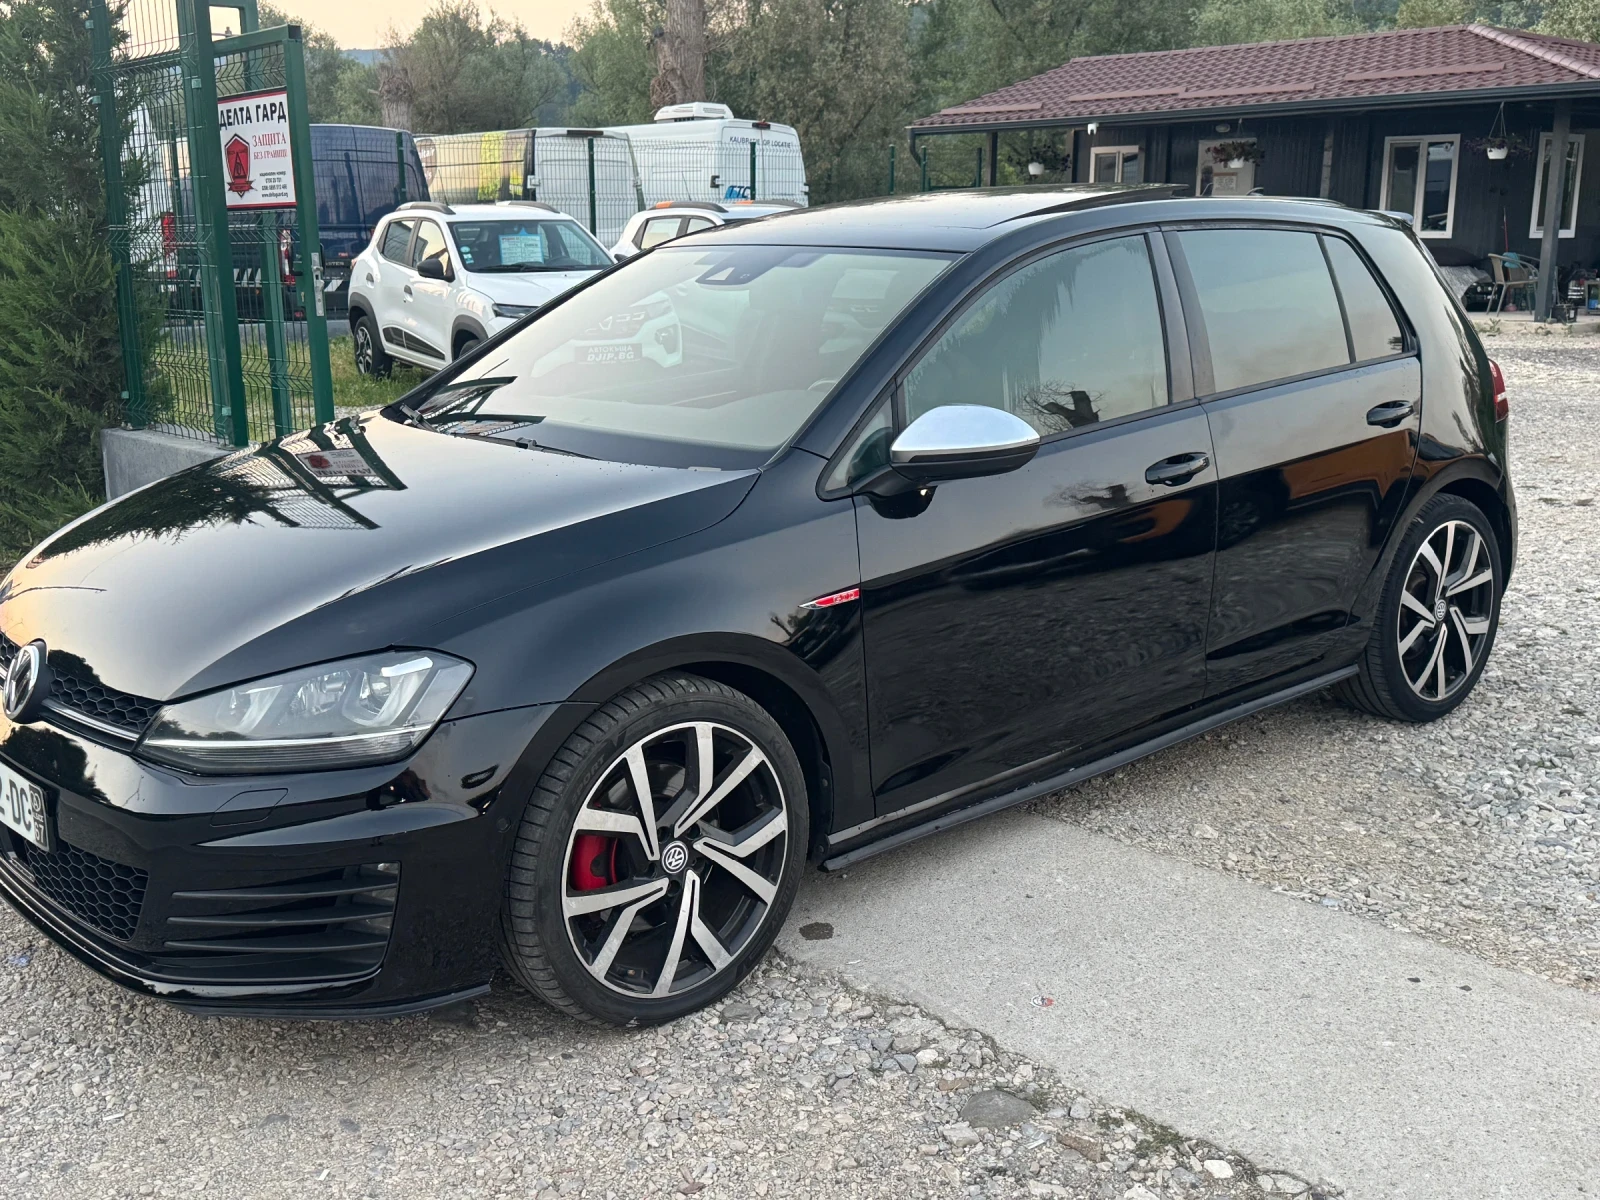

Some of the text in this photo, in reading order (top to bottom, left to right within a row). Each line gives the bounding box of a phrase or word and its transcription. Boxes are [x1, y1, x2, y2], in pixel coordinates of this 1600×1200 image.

[220, 101, 287, 130] ДЕЛТА ГАРД
[252, 132, 286, 147] ЗАЩИТА
[253, 151, 263, 160] БЕЗ
[587, 351, 635, 362] DJIP.BG
